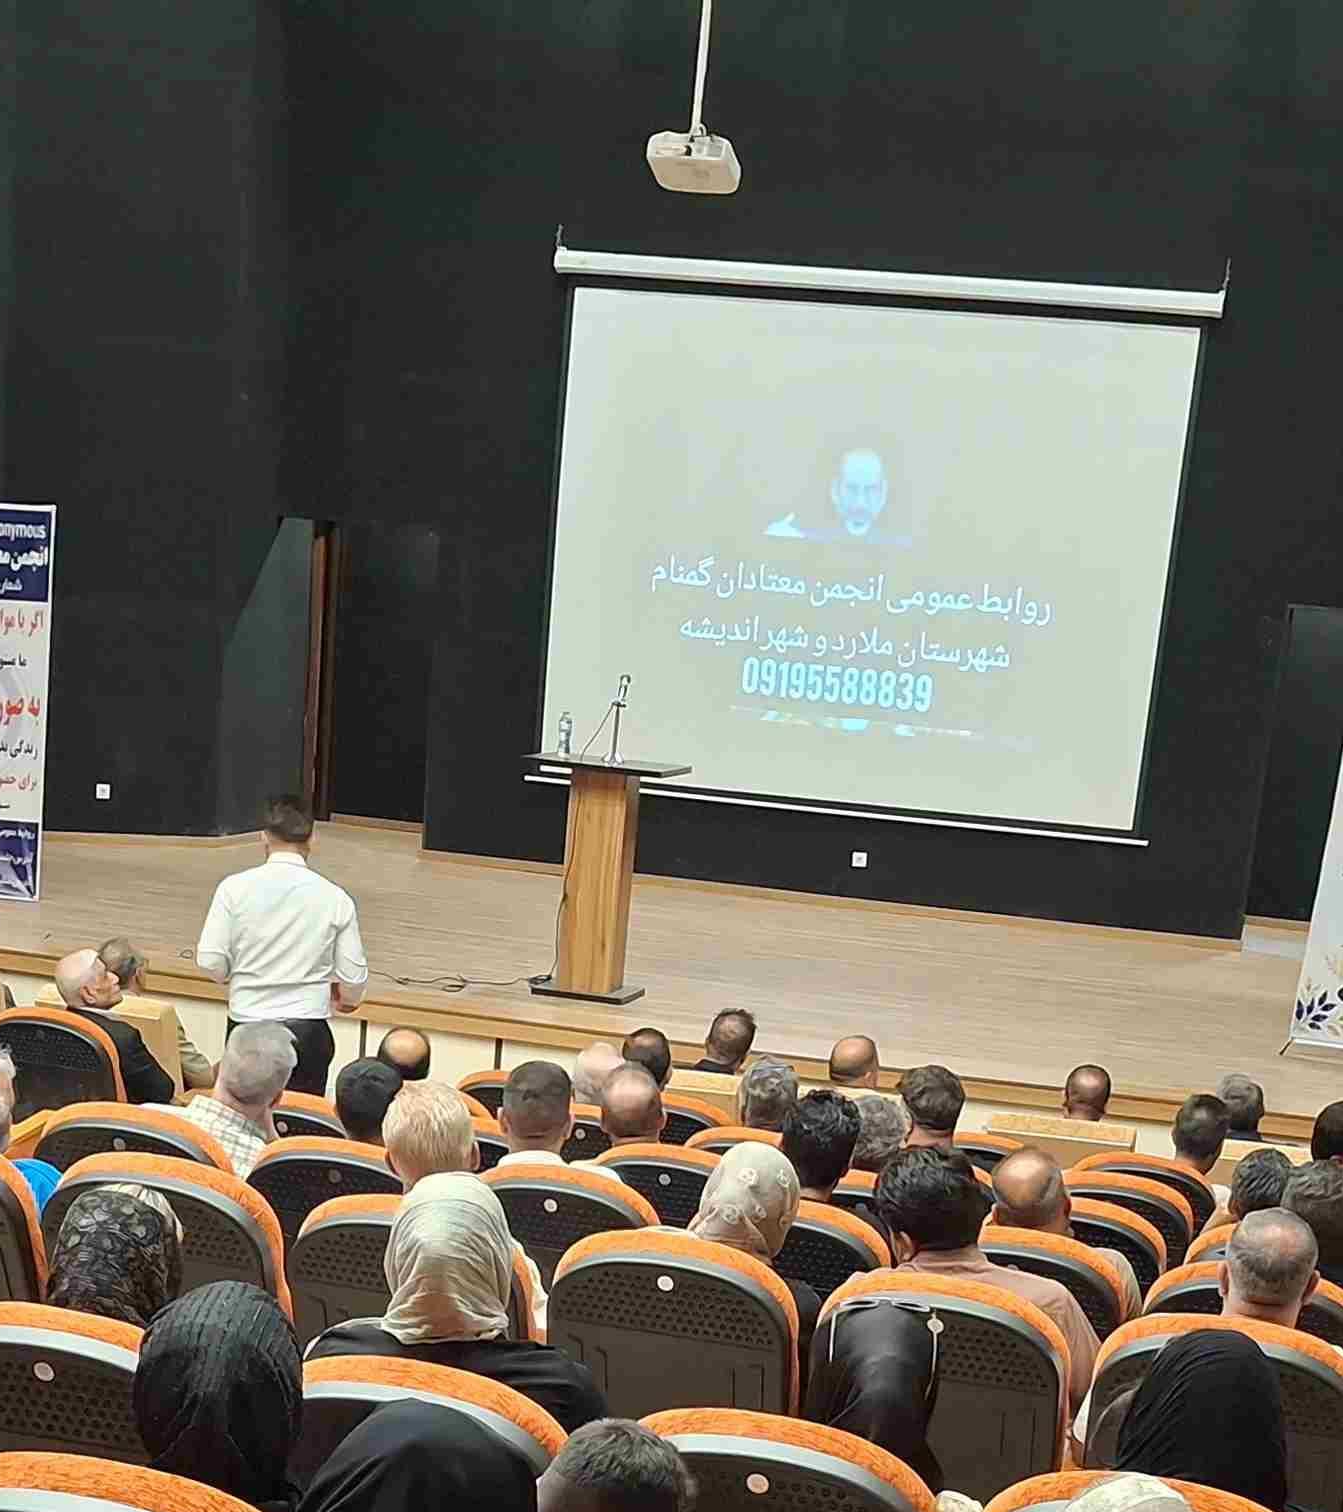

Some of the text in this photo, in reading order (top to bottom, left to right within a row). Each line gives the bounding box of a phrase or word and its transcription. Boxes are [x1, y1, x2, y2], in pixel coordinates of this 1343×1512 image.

[10, 545, 49, 571] انجمن
[650, 552, 1054, 627] روابط عمومی انجمن معتادان گمنام
[679, 615, 1011, 673] شهرستان ملارد و شهر اندیشه
[740, 654, 934, 713] 09195588839
[27, 694, 41, 727] به
[9, 738, 39, 761] زندگی
